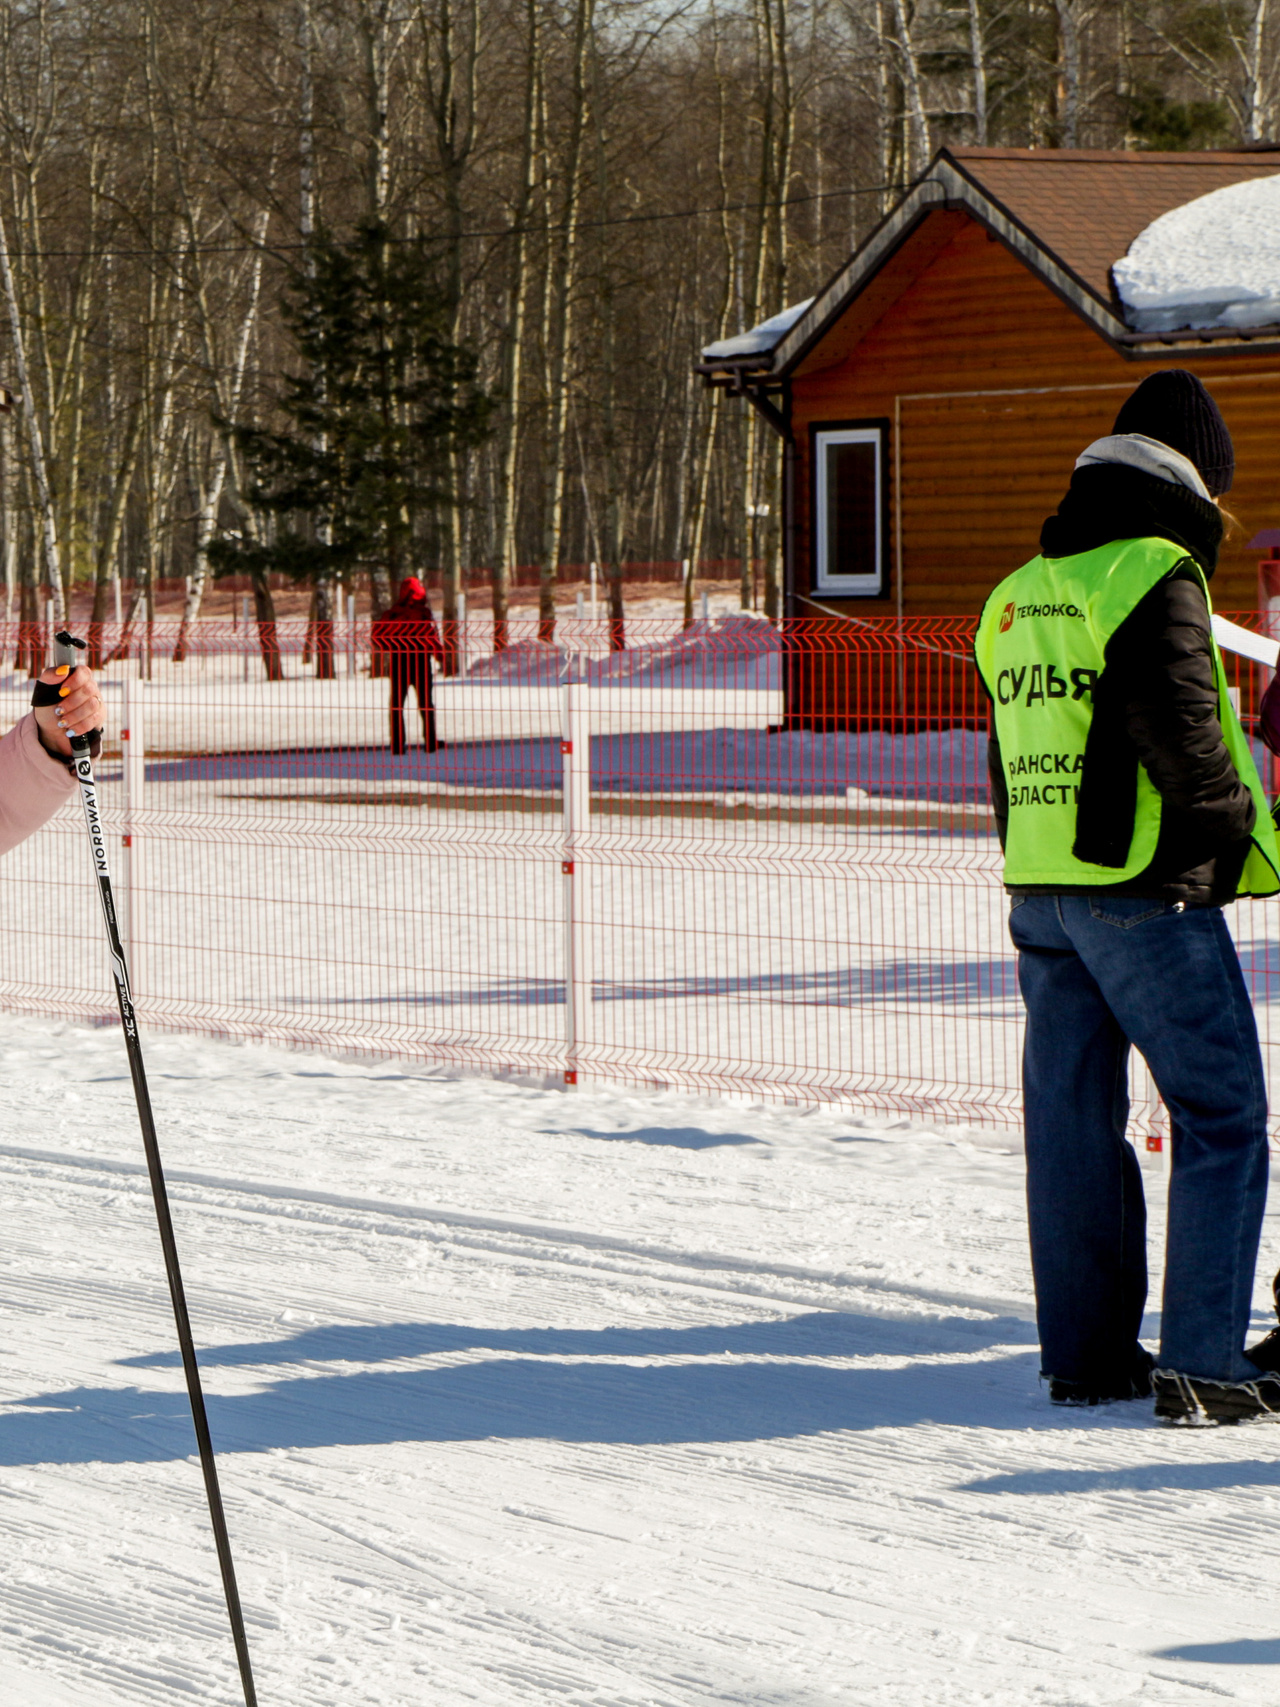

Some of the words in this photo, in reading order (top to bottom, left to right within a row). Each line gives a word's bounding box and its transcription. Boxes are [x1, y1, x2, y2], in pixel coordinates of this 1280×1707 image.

[997, 664, 1098, 707] СУДЬЯ
[86, 790, 108, 872] NORDWAY
[117, 985, 131, 1017] ACTIVE
[126, 1017, 136, 1037] XC
